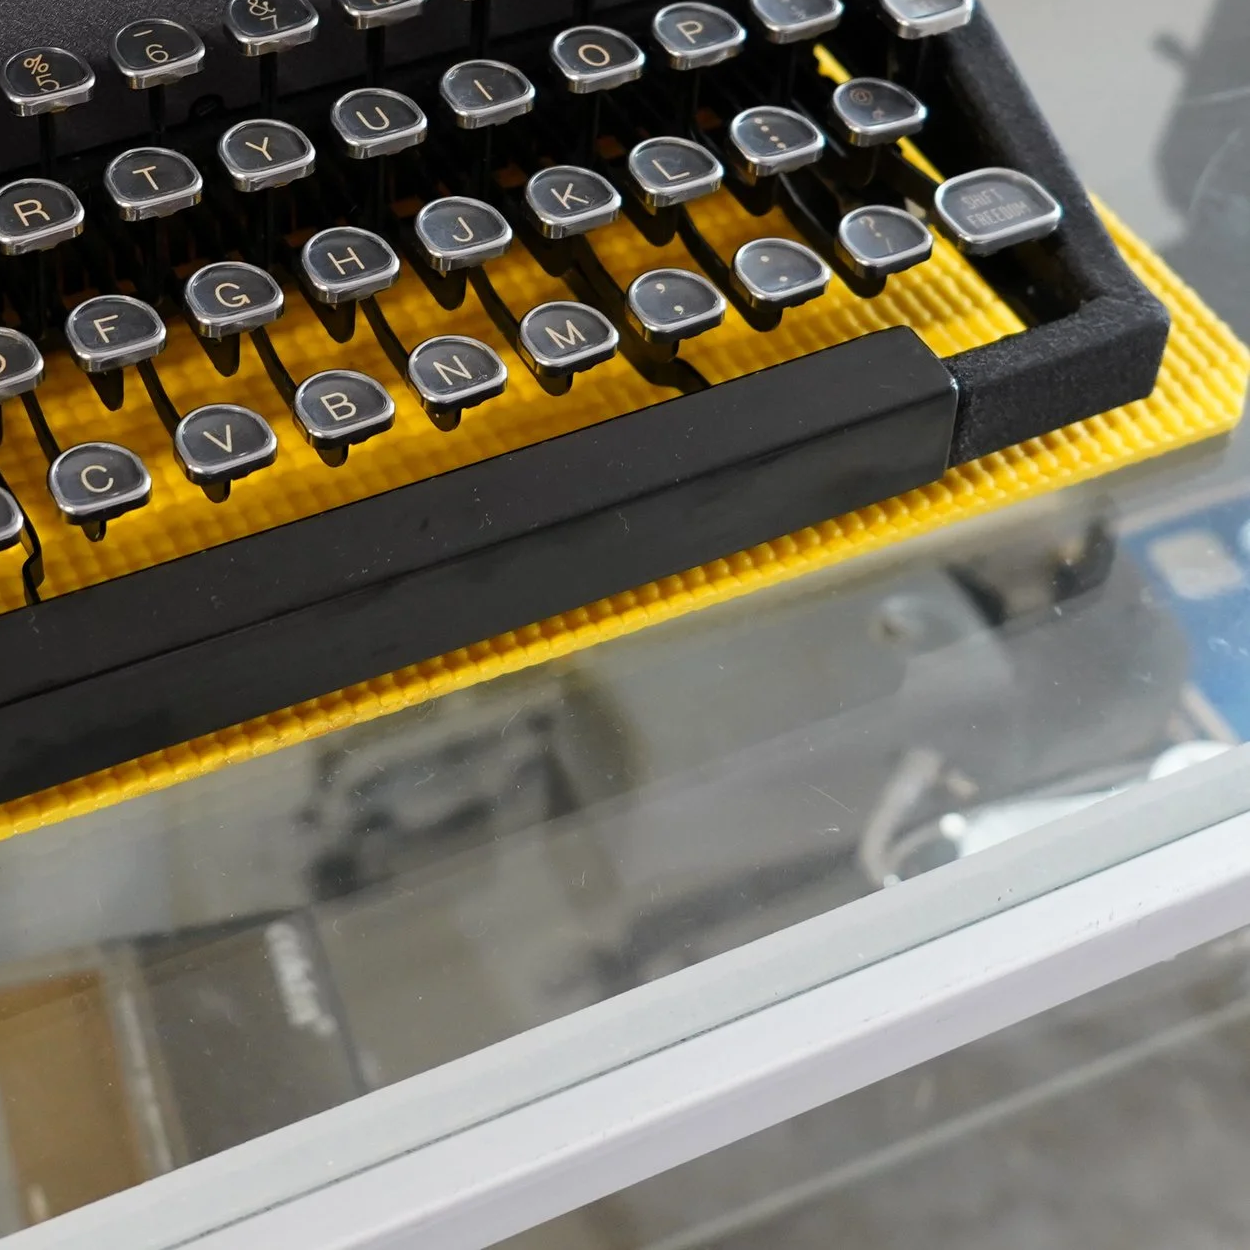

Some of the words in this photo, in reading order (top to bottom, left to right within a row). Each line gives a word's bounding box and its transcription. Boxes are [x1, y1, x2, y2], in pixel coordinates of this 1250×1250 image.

[260, 14, 278, 31] 7
[676, 21, 703, 44] P
[24, 54, 49, 75] %
[145, 43, 169, 63] 6
[36, 72, 61, 93] 5
[356, 107, 390, 130] U
[246, 137, 273, 162] Y
[133, 165, 160, 190] T
[652, 159, 691, 182] L
[550, 183, 590, 211] K
[961, 188, 1004, 210] SHIFT
[13, 199, 50, 227] R
[966, 200, 1032, 229] FREEDOM
[451, 217, 476, 242] J
[327, 246, 364, 275] H
[214, 282, 251, 308] G
[93, 314, 119, 343] F
[545, 319, 587, 349] M
[432, 355, 472, 386] N
[320, 393, 358, 421] B
[202, 424, 234, 453] V
[80, 465, 114, 493] C
